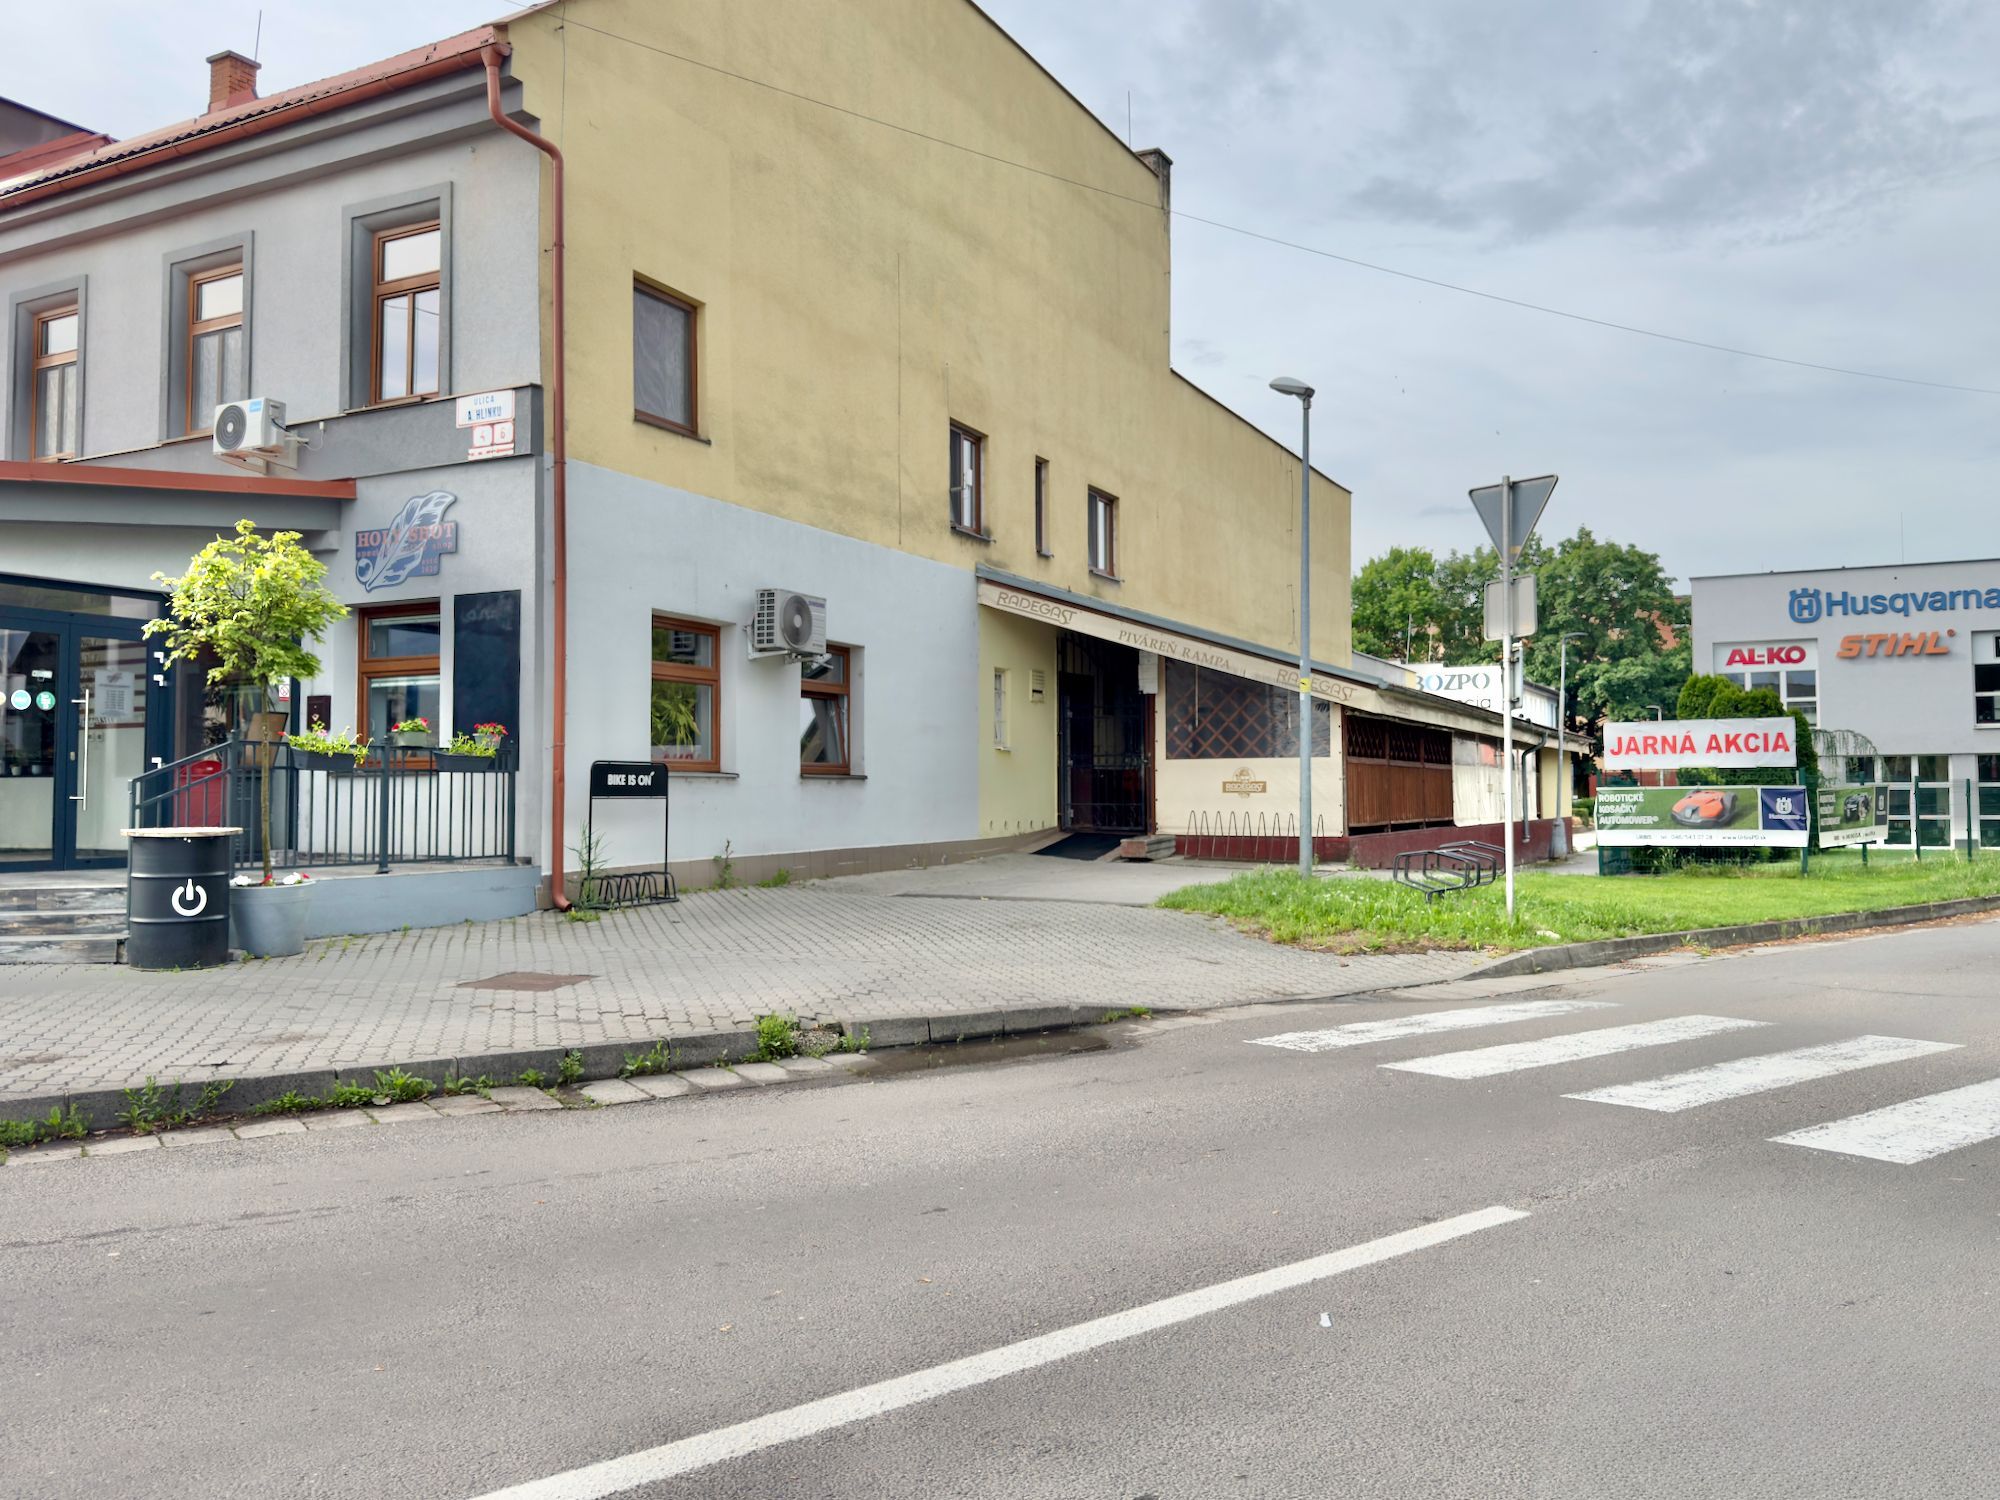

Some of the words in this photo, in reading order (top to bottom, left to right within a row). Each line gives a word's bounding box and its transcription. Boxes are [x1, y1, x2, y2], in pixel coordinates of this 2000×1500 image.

[473, 395, 495, 406] ULICA
[476, 405, 502, 420] HLINKU
[356, 528, 401, 548] HOLY
[408, 523, 454, 542] SHOT
[996, 591, 1078, 625] RADEGAST
[1825, 588, 2000, 617] Husqvarna
[1118, 630, 1178, 656] PIVÁREŇ
[1181, 647, 1231, 670] RAMPA
[1725, 645, 1807, 667] AL-KO
[1275, 668, 1358, 702] RAEGAST
[1609, 731, 1697, 756] JARNÁ
[1705, 732, 1790, 755] AKCIA
[607, 774, 627, 786] BIKE
[628, 774, 637, 786] IS
[1598, 792, 1644, 803] ROBOTICKÉ
[1598, 804, 1638, 814] KOSAČKY
